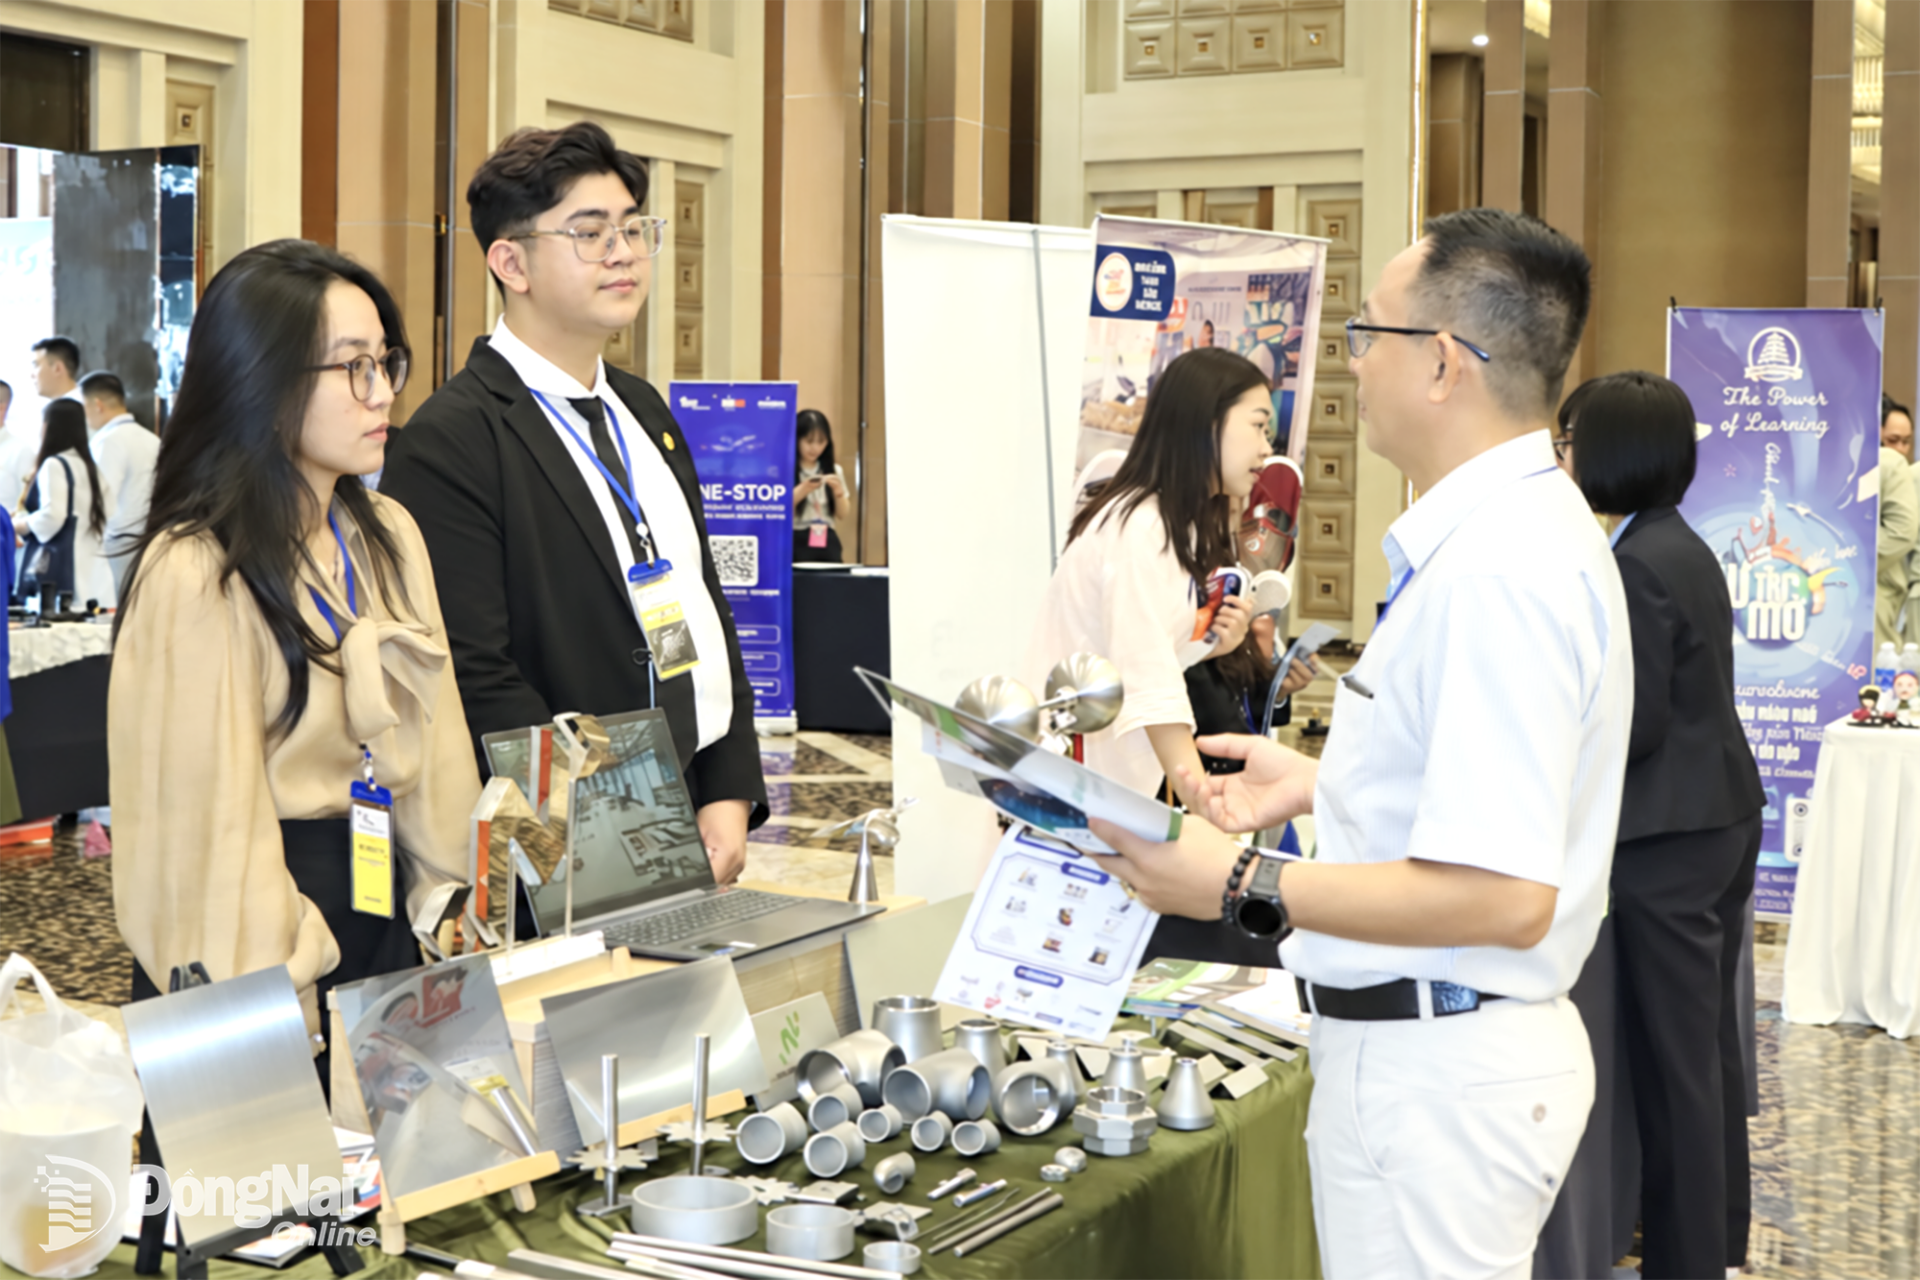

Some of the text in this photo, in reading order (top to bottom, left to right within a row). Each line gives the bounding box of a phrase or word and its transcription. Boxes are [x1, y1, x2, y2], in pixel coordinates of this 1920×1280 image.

[1723, 386, 1828, 406] The Power
[1720, 411, 1830, 439] of Learning
[700, 483, 786, 501] NE-STOP
